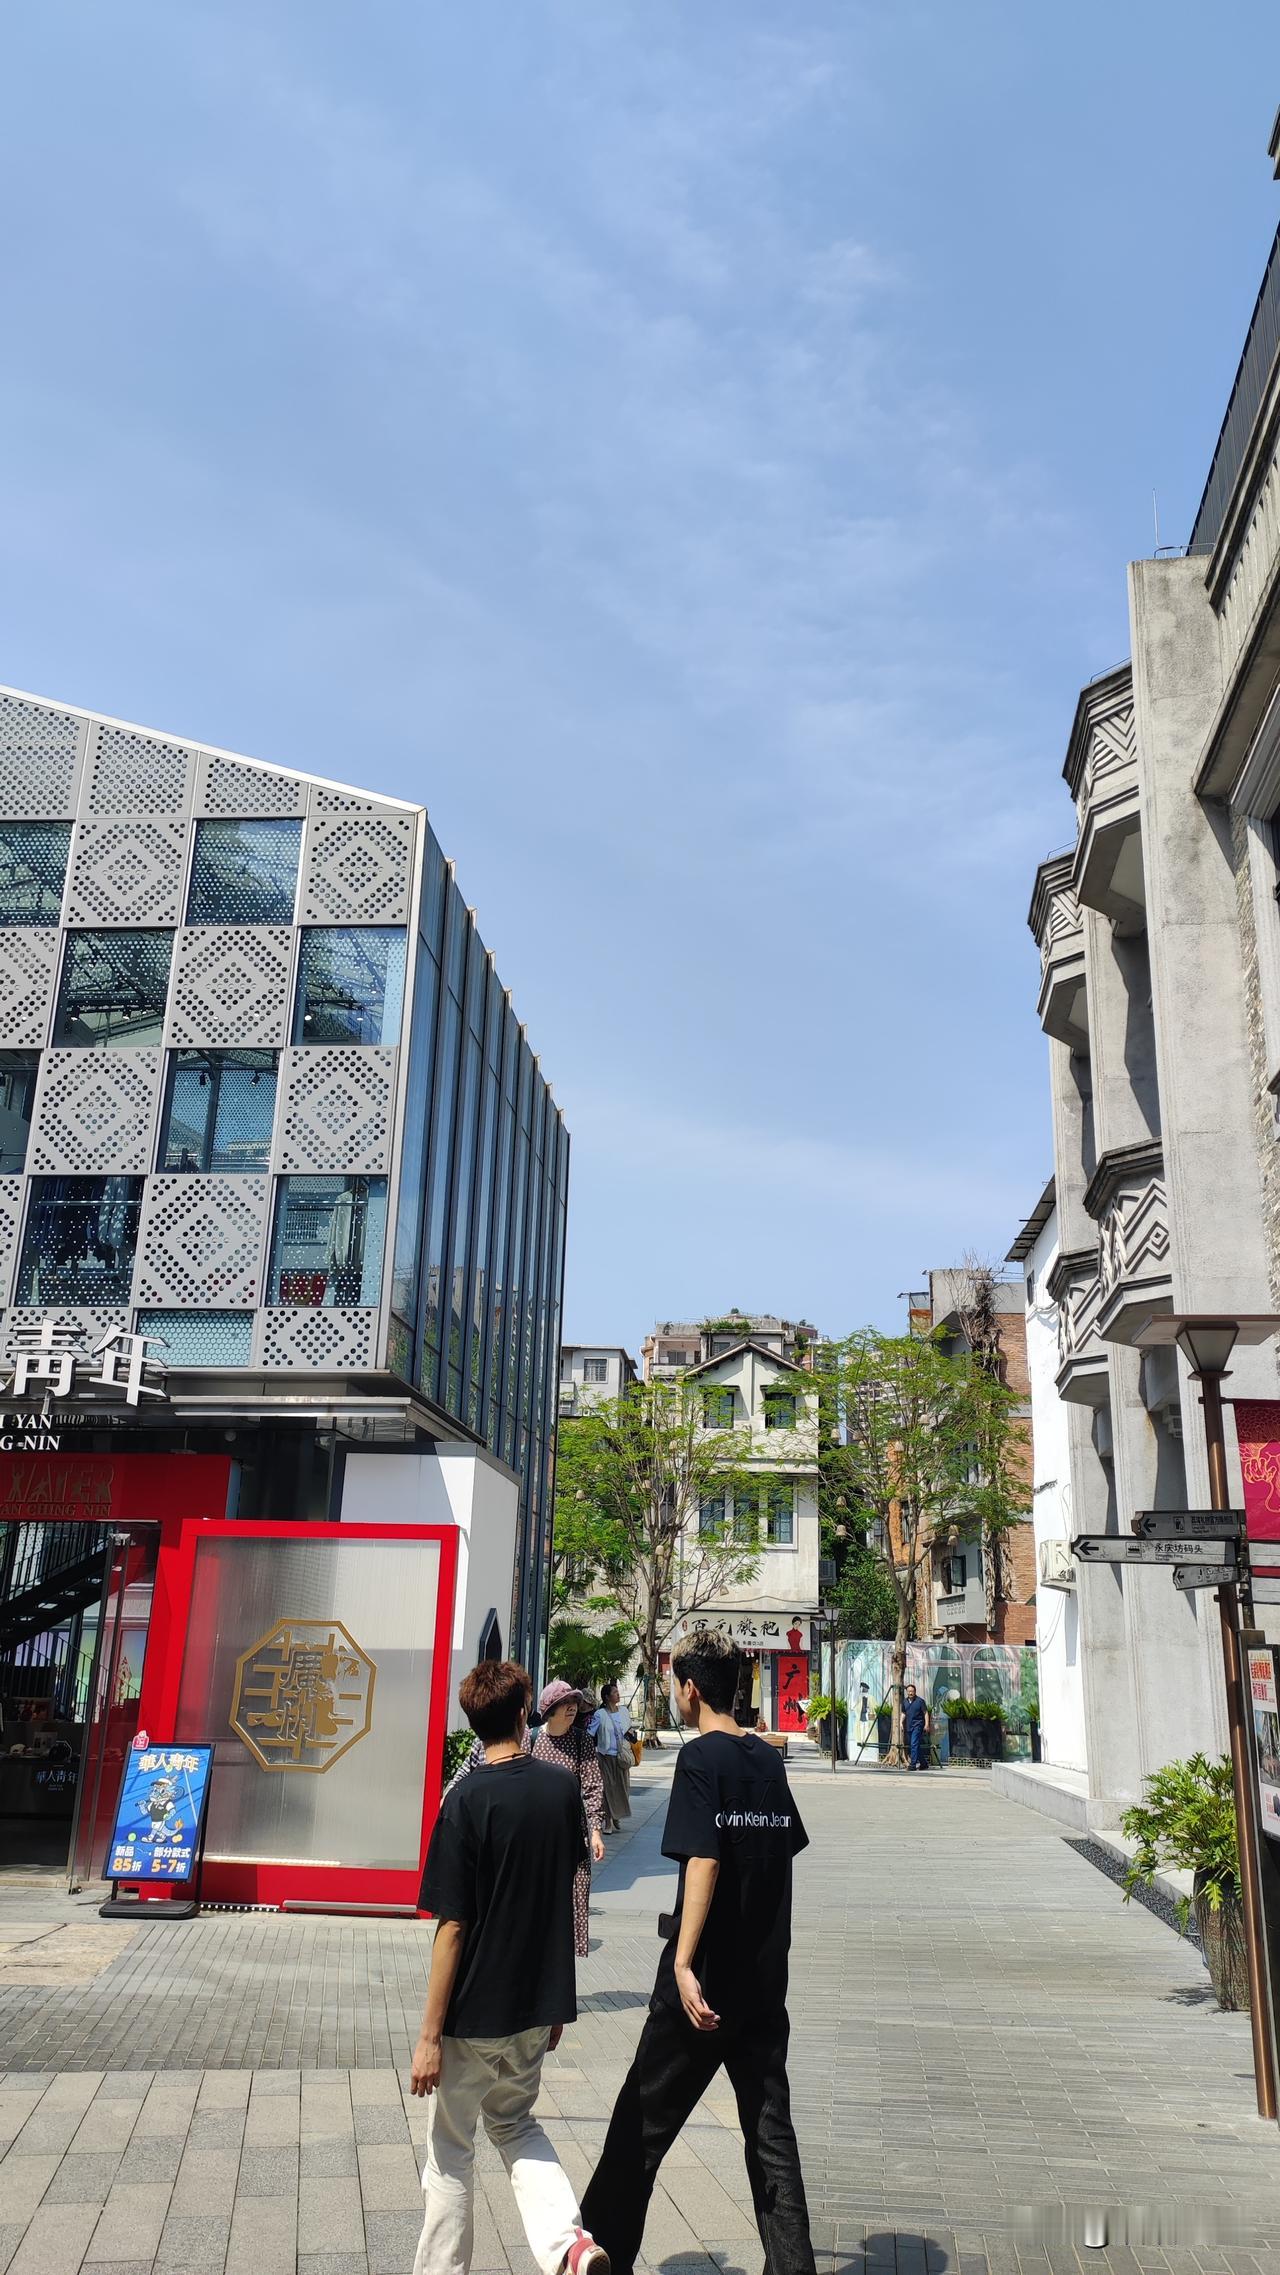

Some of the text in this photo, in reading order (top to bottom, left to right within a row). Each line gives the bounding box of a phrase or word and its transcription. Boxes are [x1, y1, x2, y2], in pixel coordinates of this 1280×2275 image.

[0, 1318, 171, 1407] 青年
[16, 1414, 53, 1429] YAN
[23, 1435, 61, 1450] NIN
[1154, 1543, 1203, 1554] 永庆坊码头
[691, 1615, 780, 1637] 百元旗袍
[783, 1663, 806, 1723] 广州
[138, 1752, 199, 1773] 華人青年
[744, 1811, 769, 1828] Klein
[115, 1845, 191, 1859] 新品 部分款式
[112, 1857, 186, 1874] 85折 5-7折
